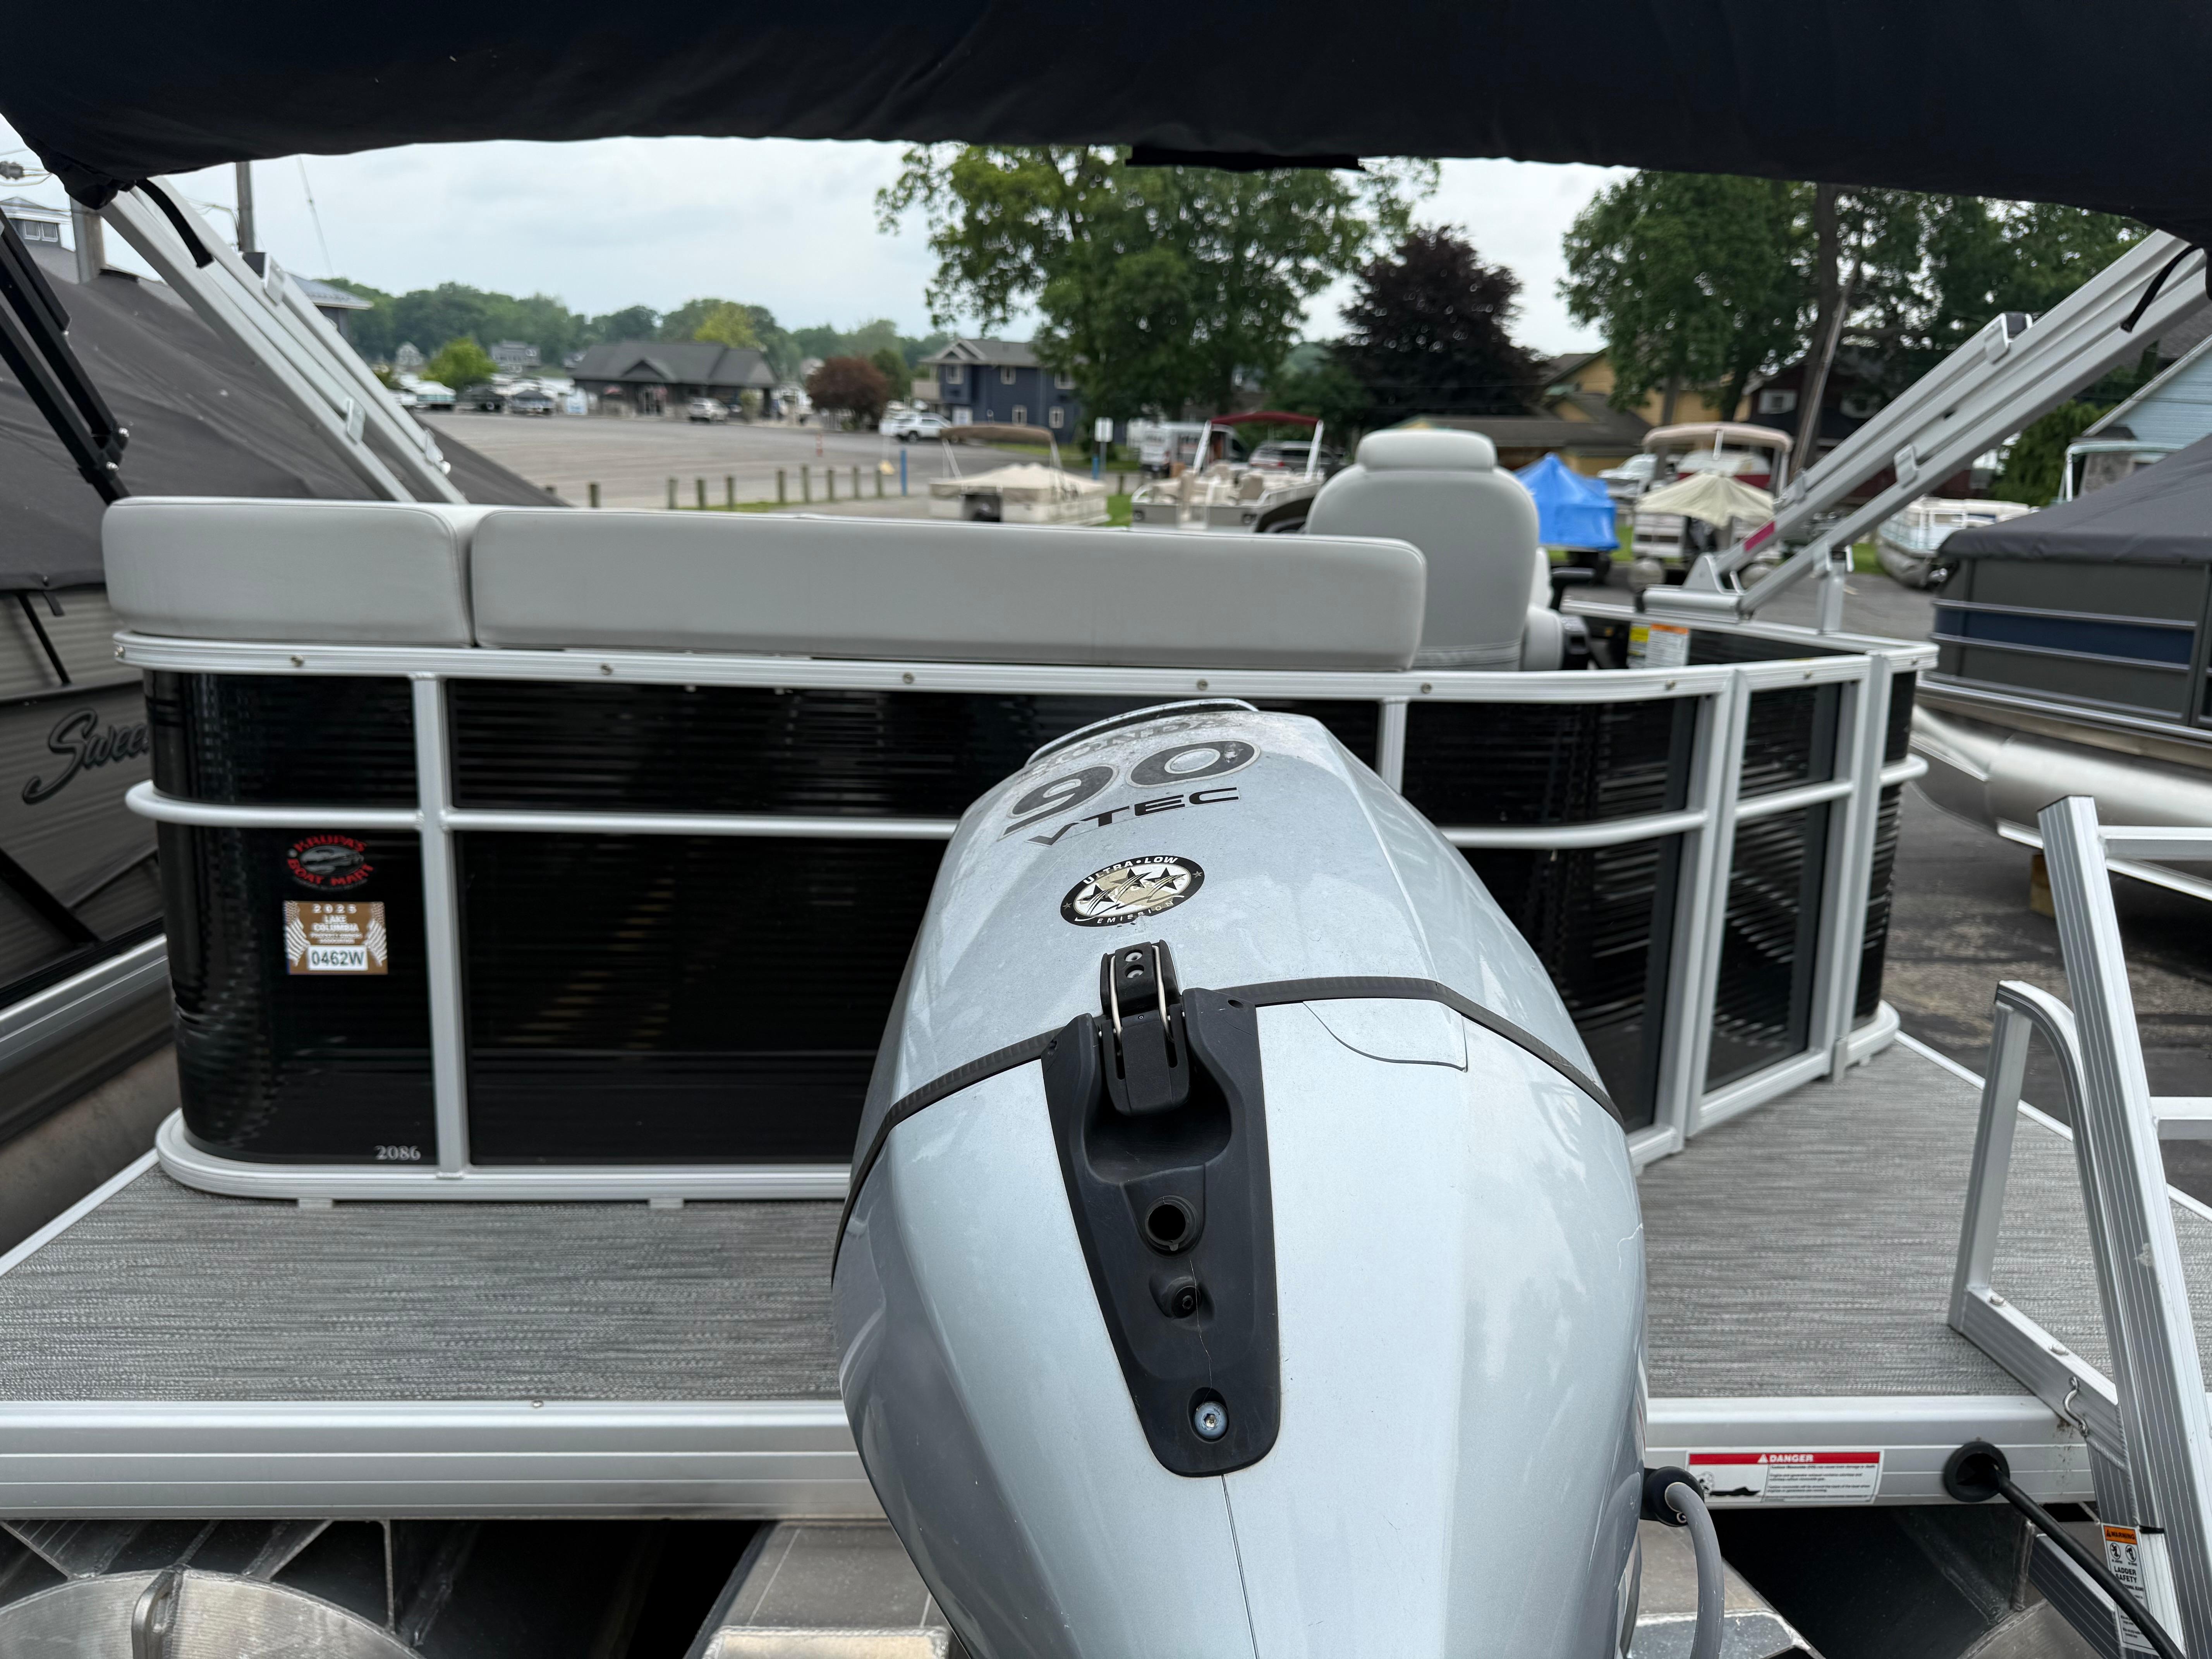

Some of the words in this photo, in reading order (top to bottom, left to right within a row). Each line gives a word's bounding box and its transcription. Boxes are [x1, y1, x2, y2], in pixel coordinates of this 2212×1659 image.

[998, 739, 1261, 840] 90
[1027, 787, 1240, 846] VTEC
[287, 858, 325, 885] BOAT
[330, 864, 374, 886] MART
[313, 903, 357, 914] 2025
[1097, 900, 1174, 924] EMISSION
[323, 914, 347, 922] LAKE
[312, 922, 359, 932] COLUMBIA
[311, 950, 364, 966] 0462W
[374, 1145, 421, 1161] 2086
[1769, 1454, 1814, 1463] DANGER
[2111, 1531, 2135, 1540] WARNING
[2114, 1566, 2137, 1576] LADDER
[2115, 1573, 2137, 1583] SAFETY
